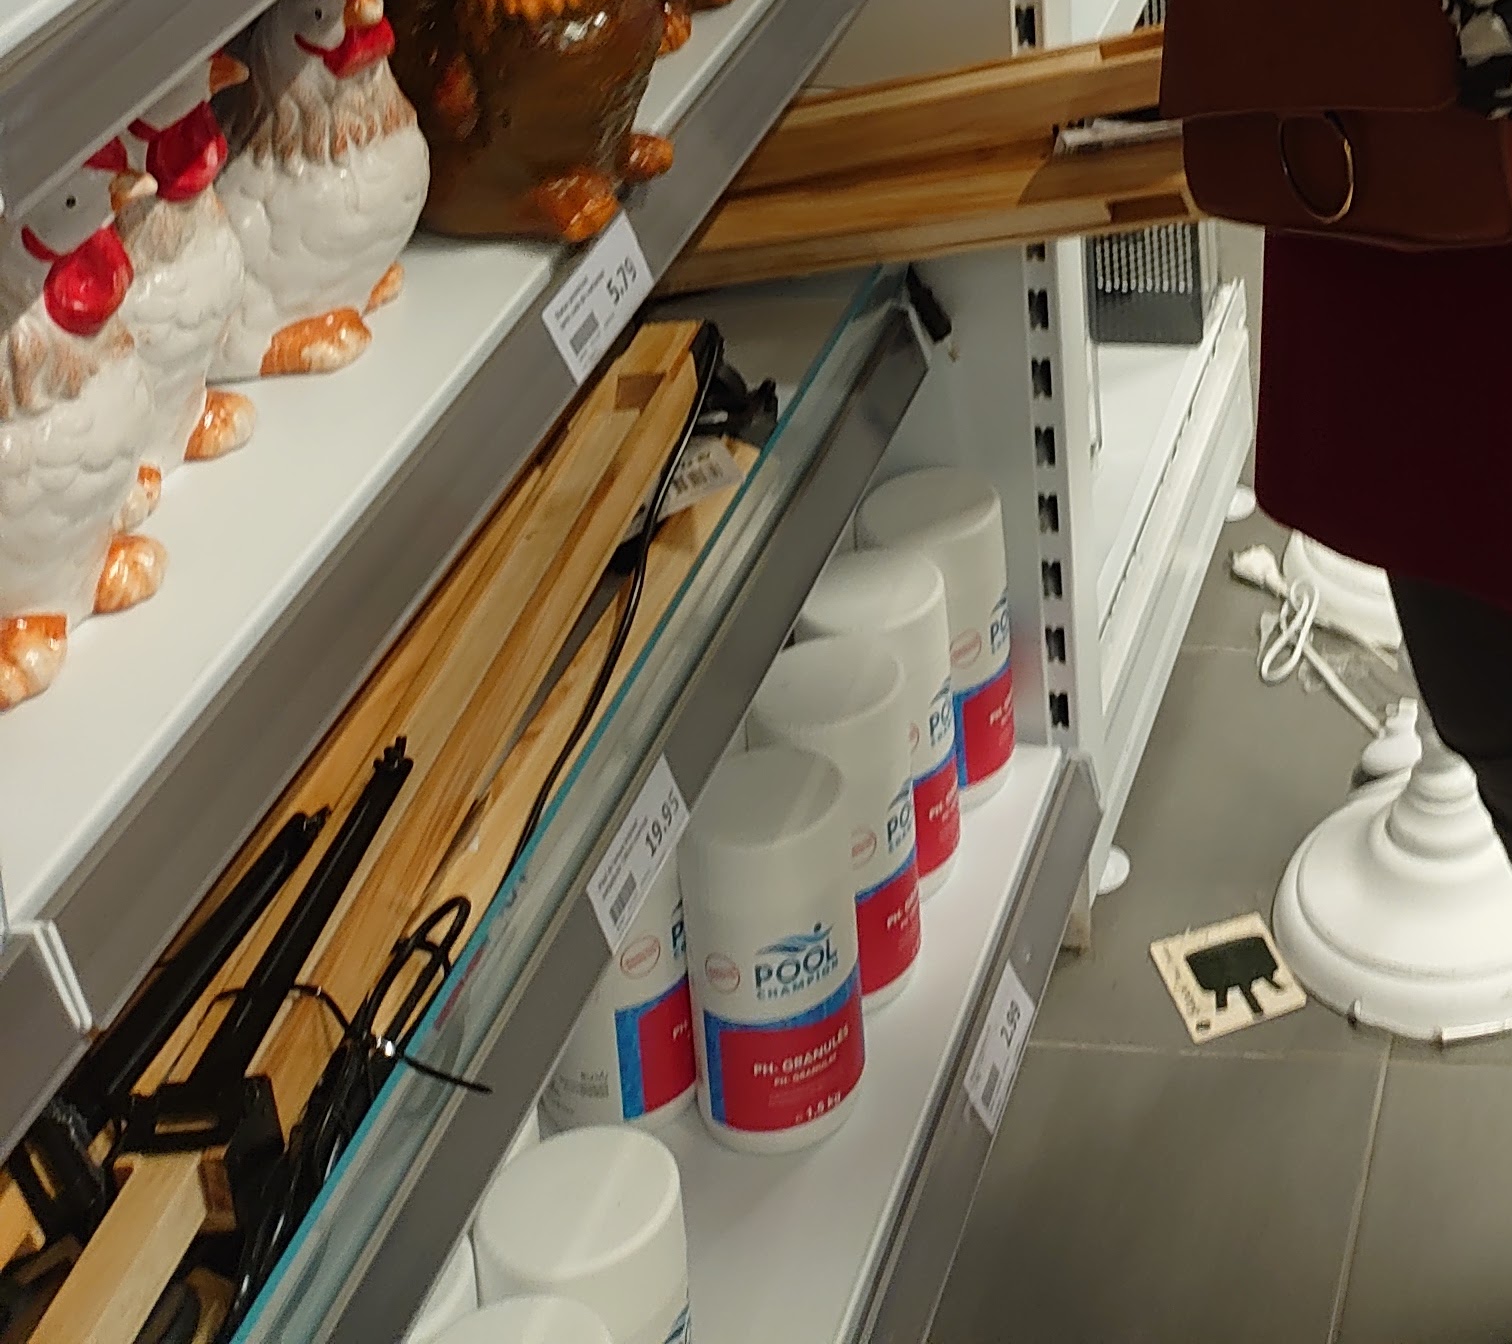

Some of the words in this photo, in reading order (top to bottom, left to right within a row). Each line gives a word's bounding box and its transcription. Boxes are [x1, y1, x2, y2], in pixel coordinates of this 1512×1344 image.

[605, 256, 638, 307] 5.79
[644, 786, 680, 858] 19.95
[754, 937, 838, 989] POOL
[756, 956, 840, 1001] CHAMPION
